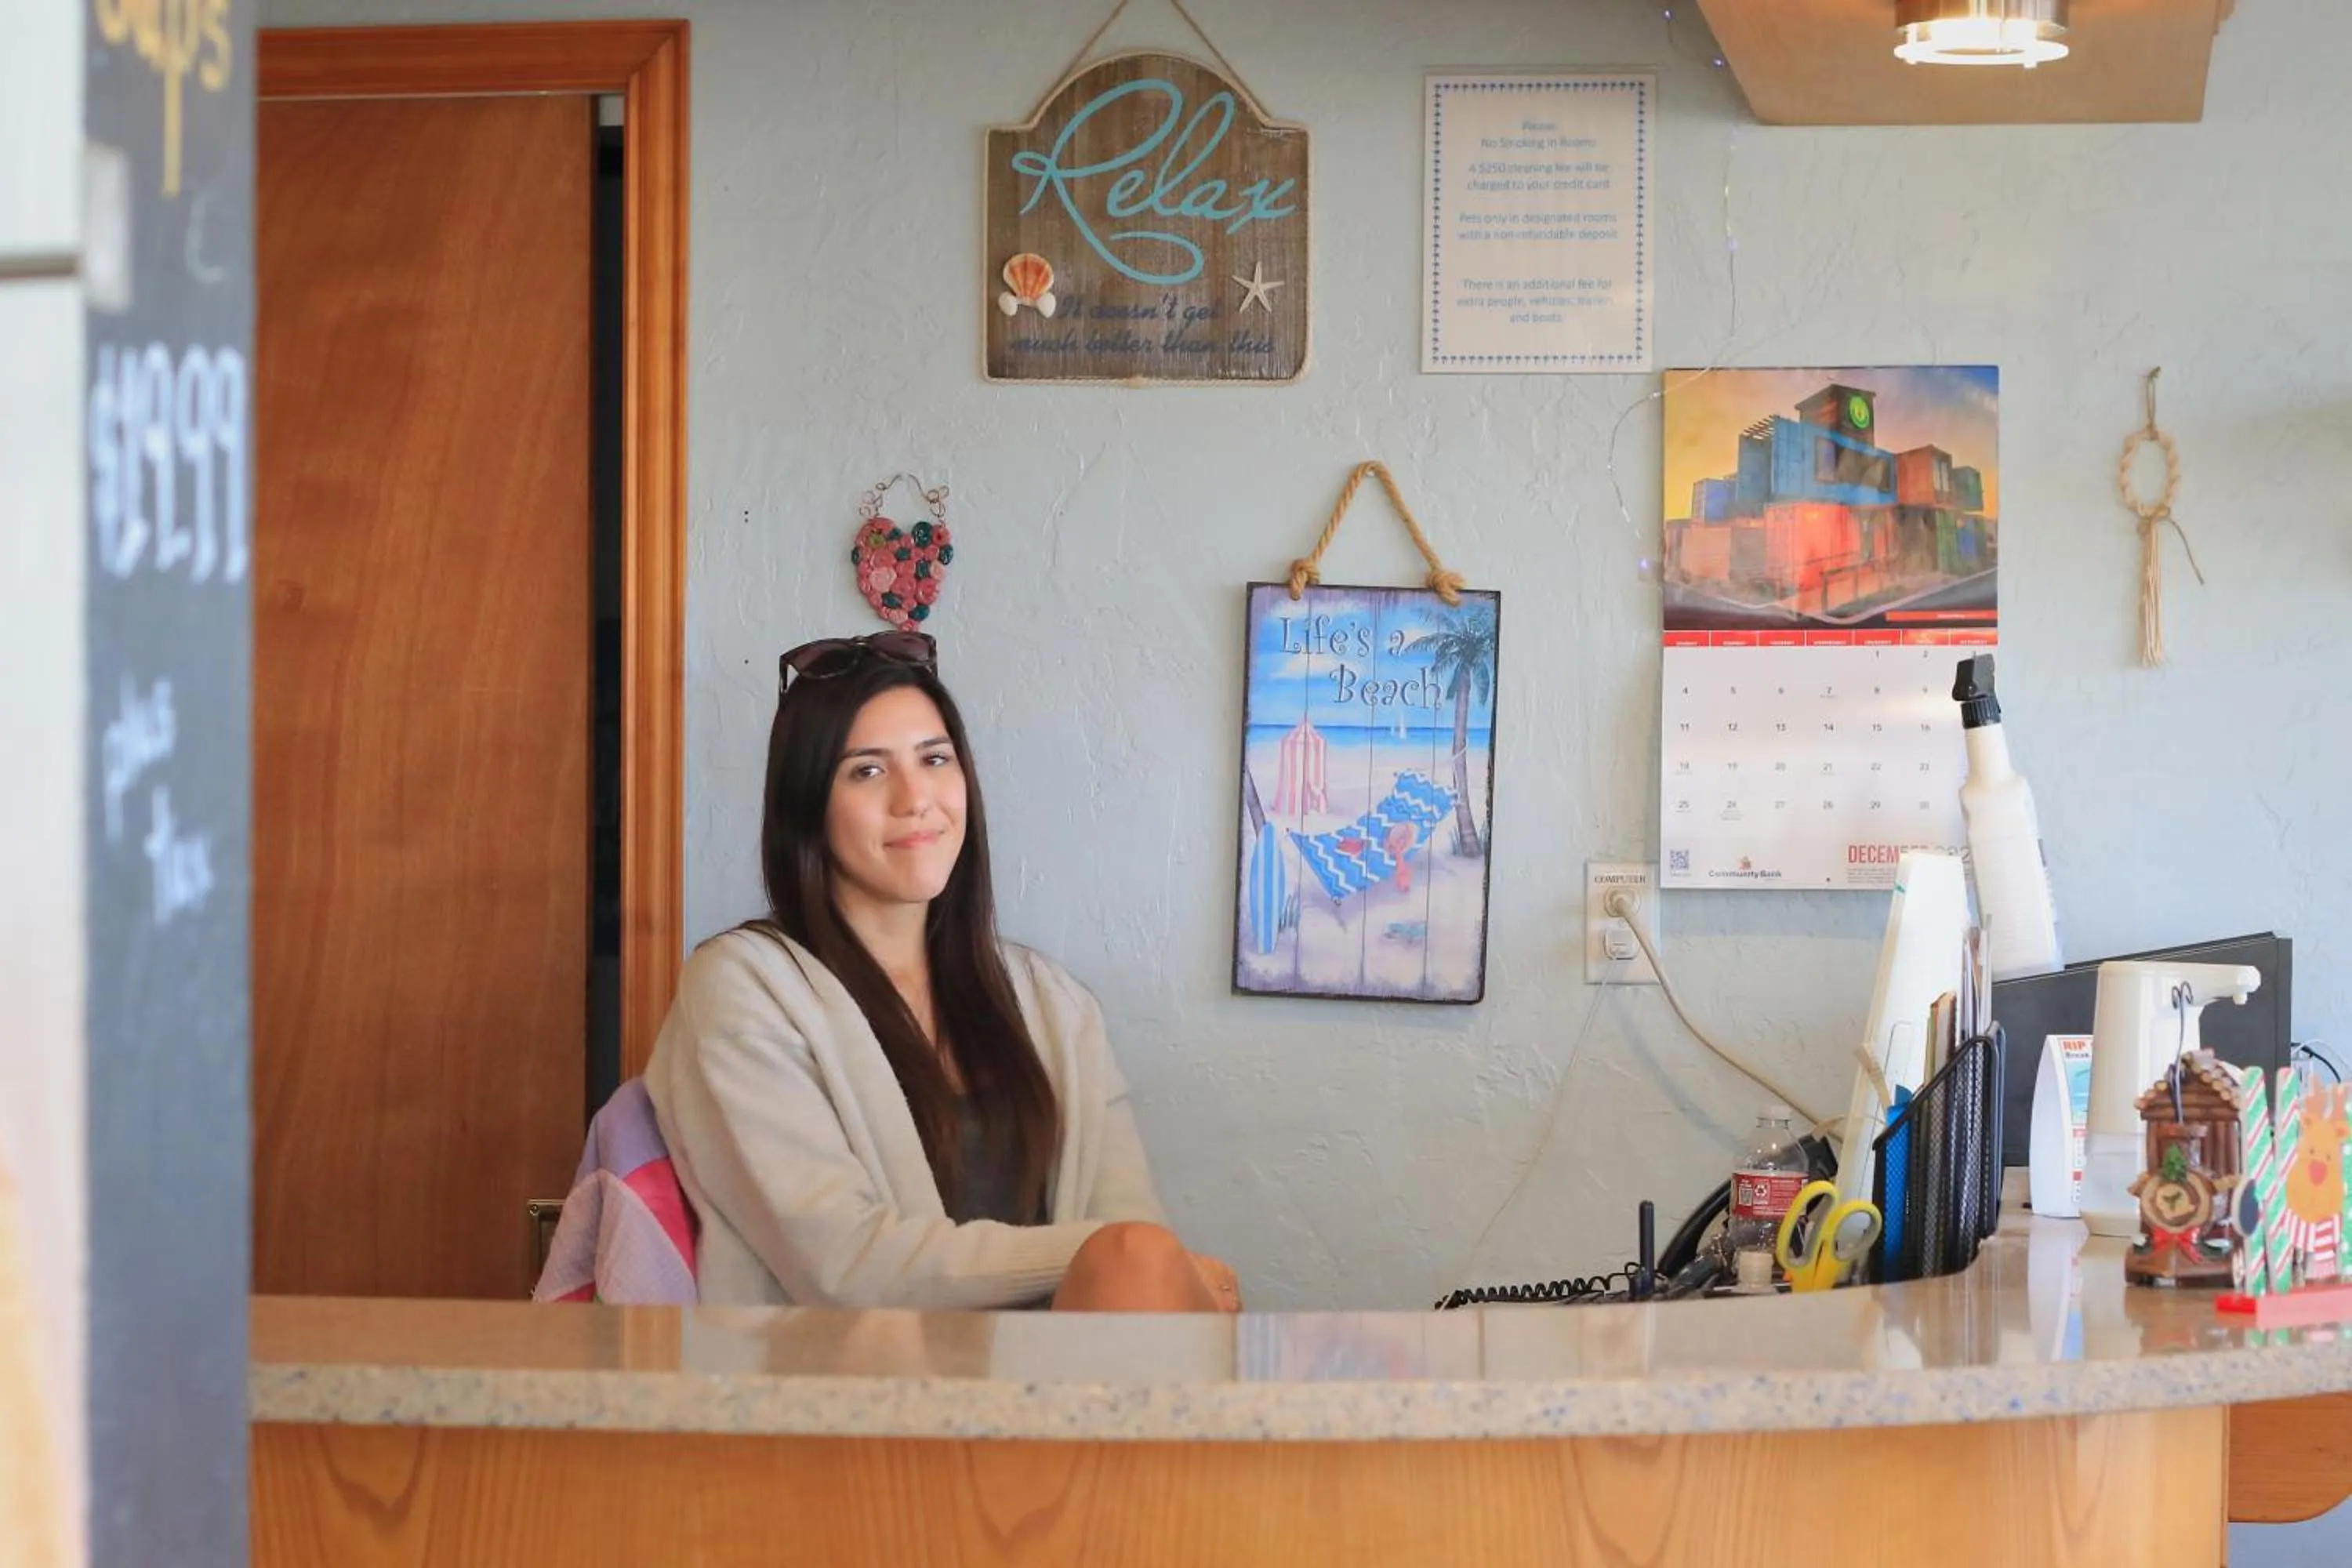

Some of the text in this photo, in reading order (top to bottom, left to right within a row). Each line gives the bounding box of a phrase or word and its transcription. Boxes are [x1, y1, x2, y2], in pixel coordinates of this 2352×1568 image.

[1481, 137, 1497, 148] No
[1498, 136, 1544, 149] Smoking
[1547, 137, 1557, 147] in
[1011, 78, 1296, 286] Relax
[1512, 180, 1525, 191] to
[1483, 212, 1506, 226] only
[1508, 212, 1519, 223] in
[1162, 327, 1217, 353] than
[1279, 614, 1406, 658] Life's a
[1329, 663, 1443, 710] Beach
[1848, 844, 1929, 863] DECEM
